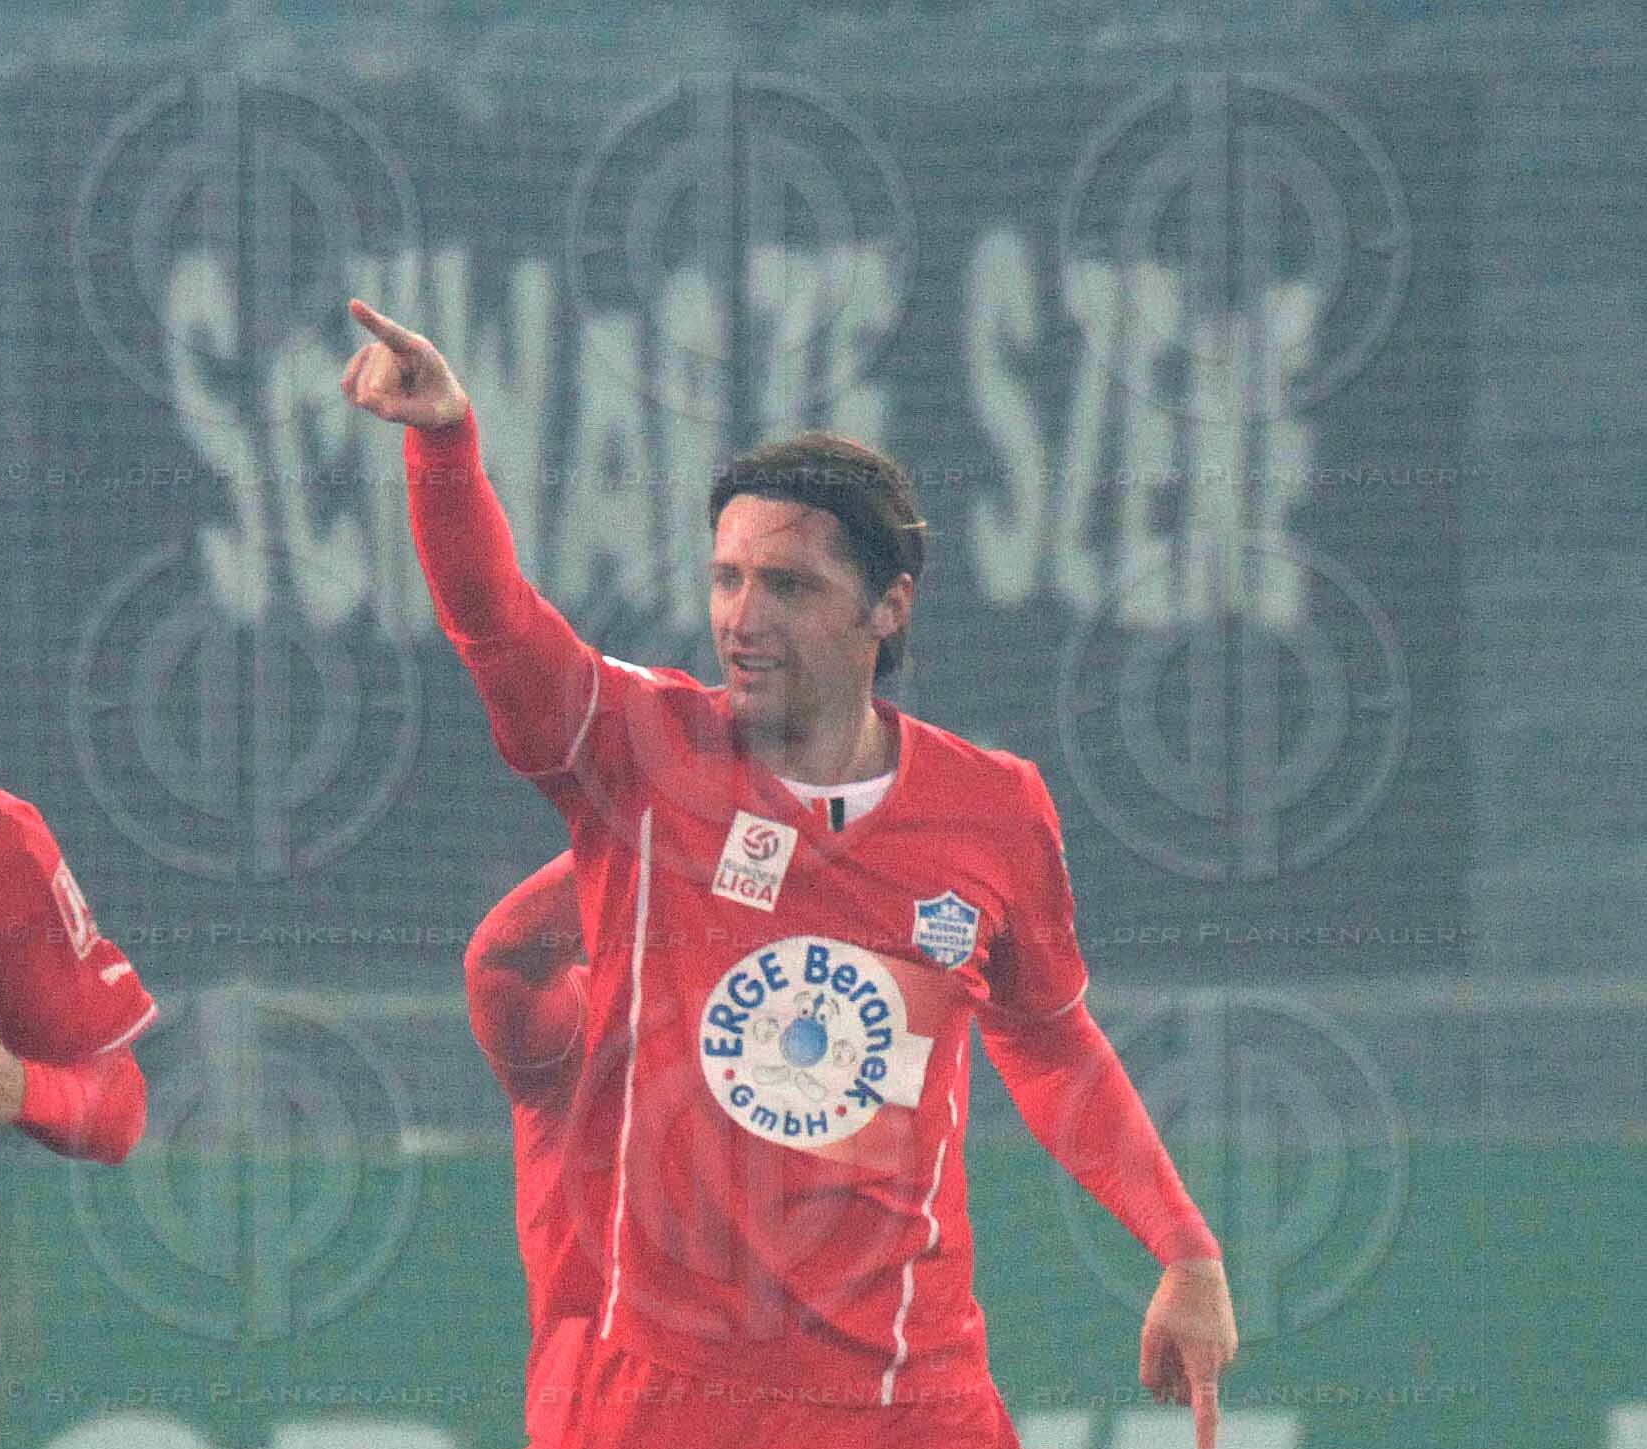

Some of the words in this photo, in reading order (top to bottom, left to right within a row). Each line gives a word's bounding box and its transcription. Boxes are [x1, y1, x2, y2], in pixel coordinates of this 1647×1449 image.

[717, 871, 772, 902] LIGA
[704, 951, 790, 1058] ERGE
[803, 943, 893, 1108] Beranek
[729, 1083, 829, 1137] GmbH
